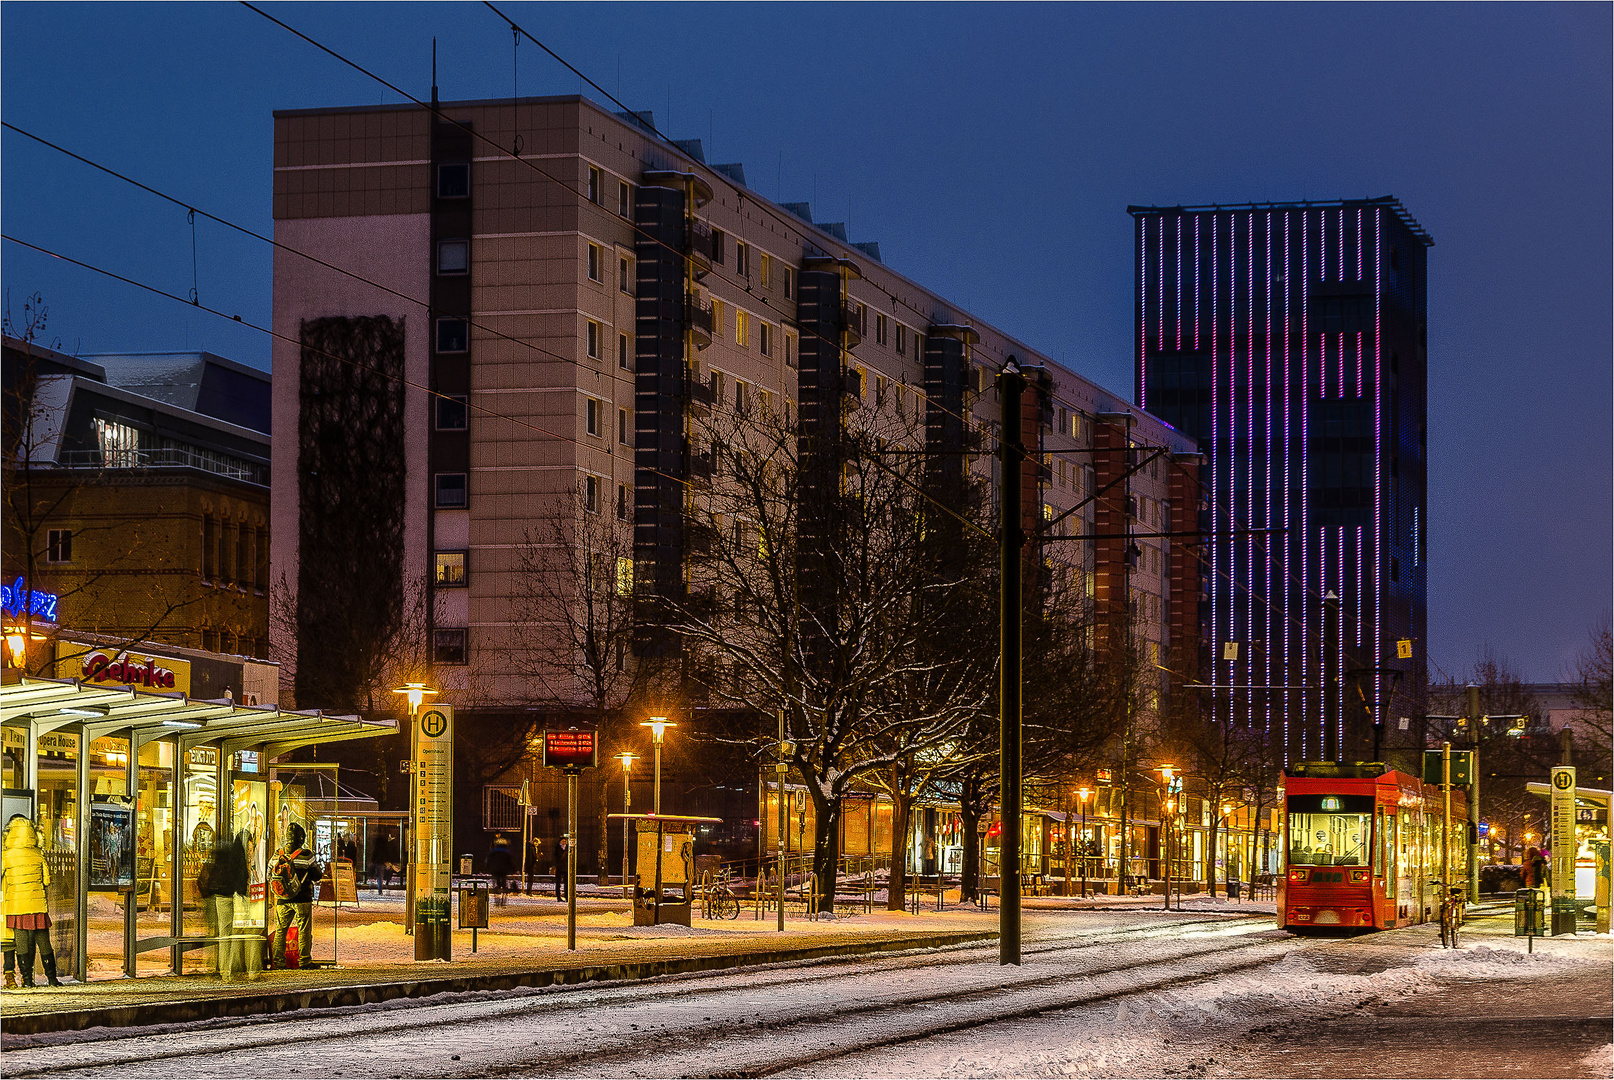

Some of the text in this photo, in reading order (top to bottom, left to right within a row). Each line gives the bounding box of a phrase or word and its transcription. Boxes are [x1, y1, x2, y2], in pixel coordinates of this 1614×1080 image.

[82, 651, 175, 688] Gehrke
[428, 716, 439, 731] H
[58, 734, 76, 748] House
[1560, 775, 1568, 786] H
